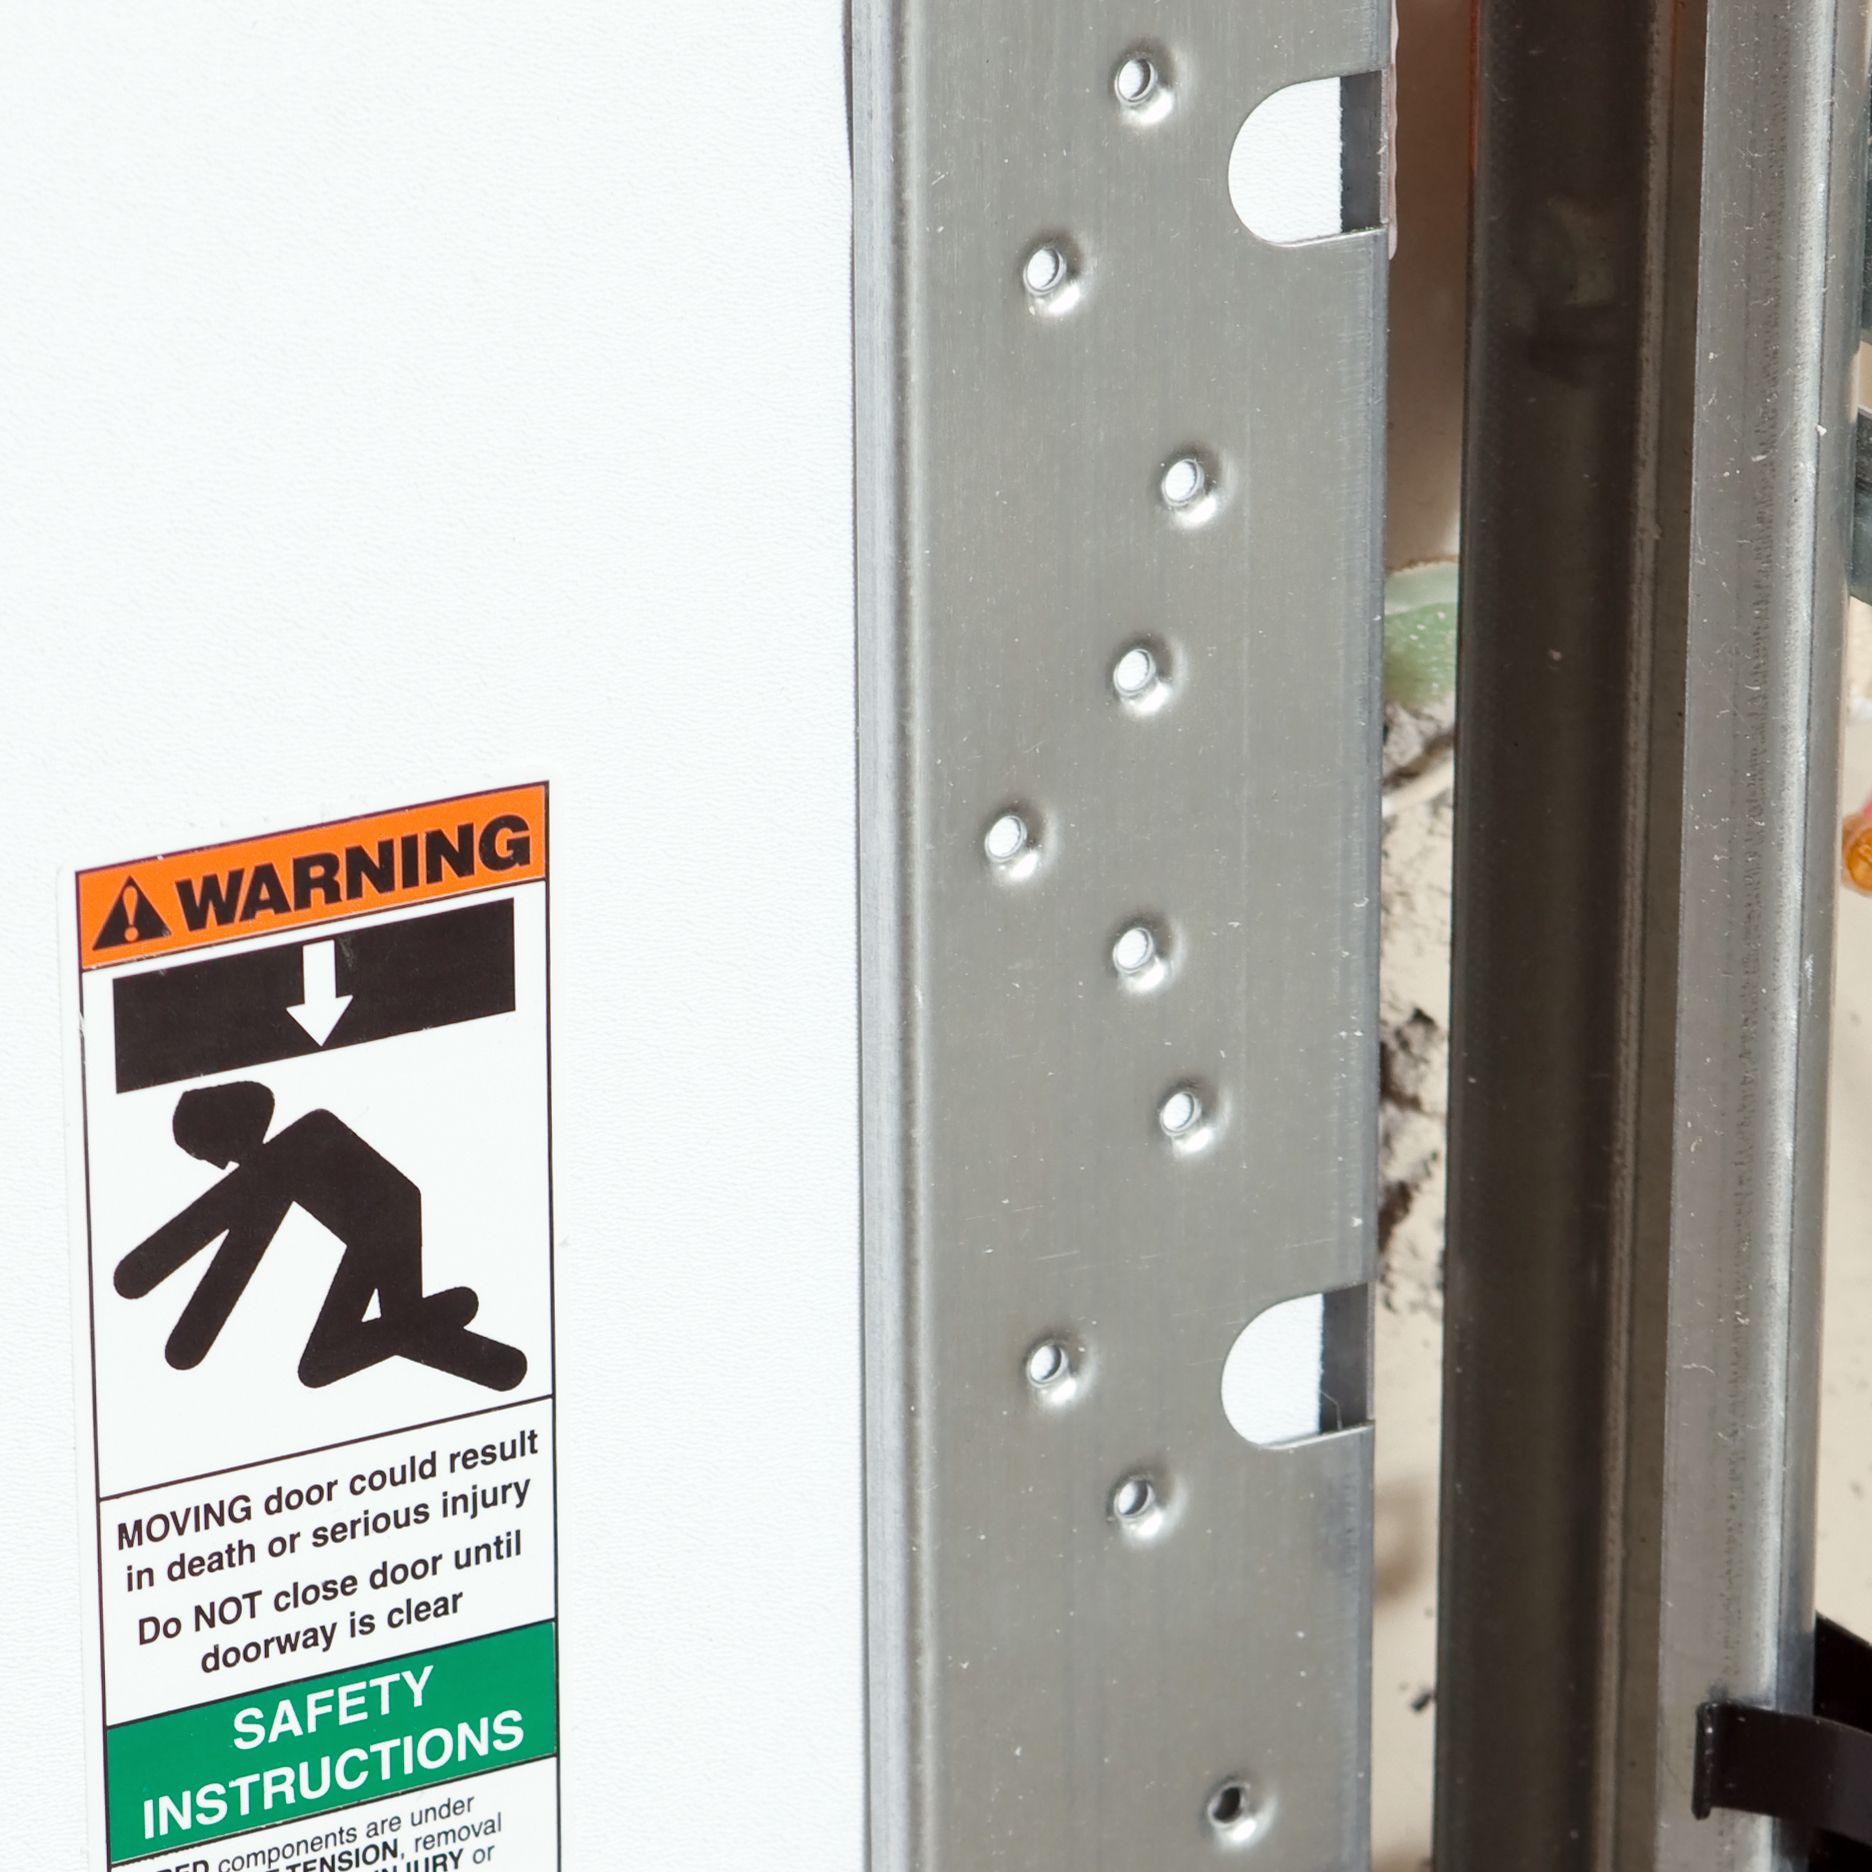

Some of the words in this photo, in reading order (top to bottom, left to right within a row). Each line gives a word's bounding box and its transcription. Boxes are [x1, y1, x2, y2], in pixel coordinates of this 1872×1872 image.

[175, 815, 530, 931] WARNING
[116, 1493, 253, 1552] MOVING
[263, 1477, 339, 1517] door
[348, 1449, 438, 1497] could
[448, 1428, 539, 1475] result
[125, 1563, 155, 1593] in
[165, 1537, 256, 1583] death
[266, 1530, 302, 1559] or
[310, 1501, 431, 1549] serious
[441, 1477, 532, 1520] injury
[137, 1614, 183, 1647] Do
[193, 1588, 264, 1633] NOT
[272, 1573, 359, 1613] close
[368, 1552, 444, 1591] door
[453, 1527, 522, 1571] until
[200, 1620, 339, 1674] doorway
[348, 1609, 377, 1639] is
[386, 1590, 464, 1630] clear
[233, 1664, 434, 1750] SAFETY
[143, 1708, 524, 1840] INSTRUCTIONS
[364, 1814, 403, 1840] are
[409, 1795, 476, 1828] under
[413, 1810, 502, 1854] removal
[471, 1843, 496, 1865] or
